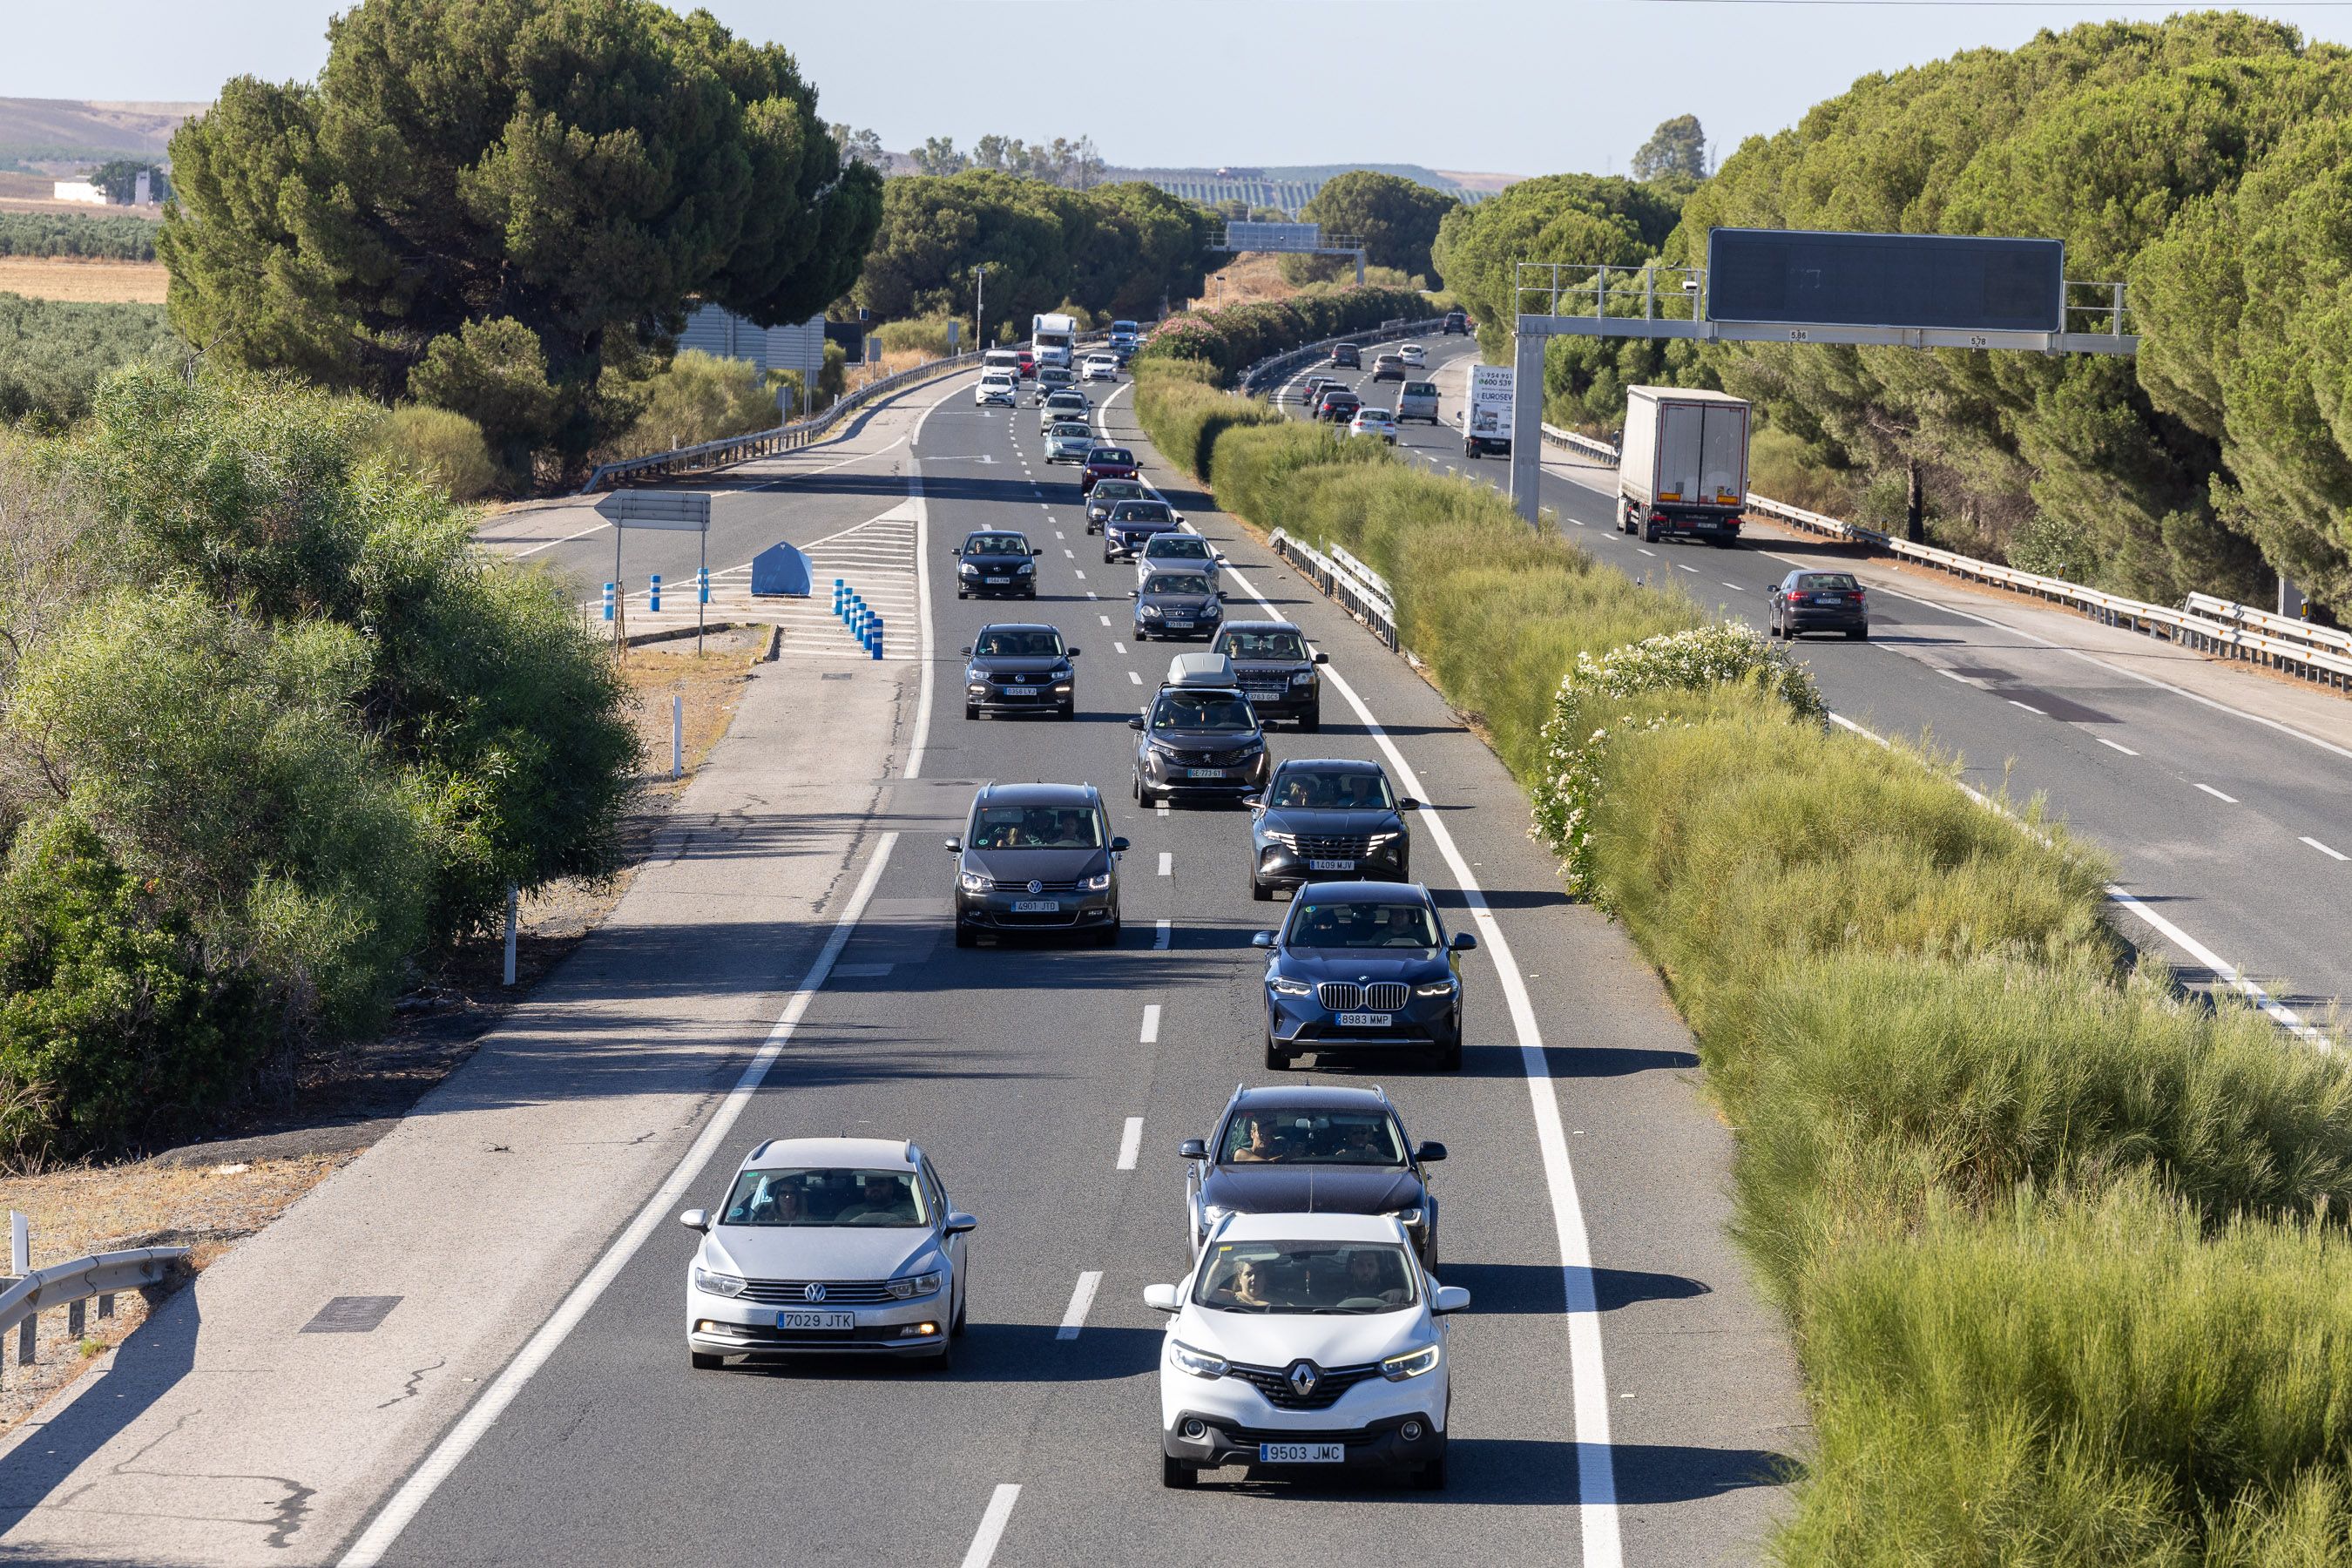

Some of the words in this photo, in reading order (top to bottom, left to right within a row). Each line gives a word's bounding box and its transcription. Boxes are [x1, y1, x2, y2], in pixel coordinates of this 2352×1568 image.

[1316, 861, 1335, 869] 1409
[1337, 861, 1352, 869] MJV
[1017, 902, 1037, 910] 4901
[1041, 902, 1055, 910] JTD
[1342, 1015, 1367, 1024] 8983
[1370, 1015, 1389, 1024] MMP
[787, 1314, 821, 1327] 7029
[826, 1315, 851, 1327] JTK
[1270, 1446, 1308, 1460] 9503
[1313, 1446, 1340, 1460] JMC
